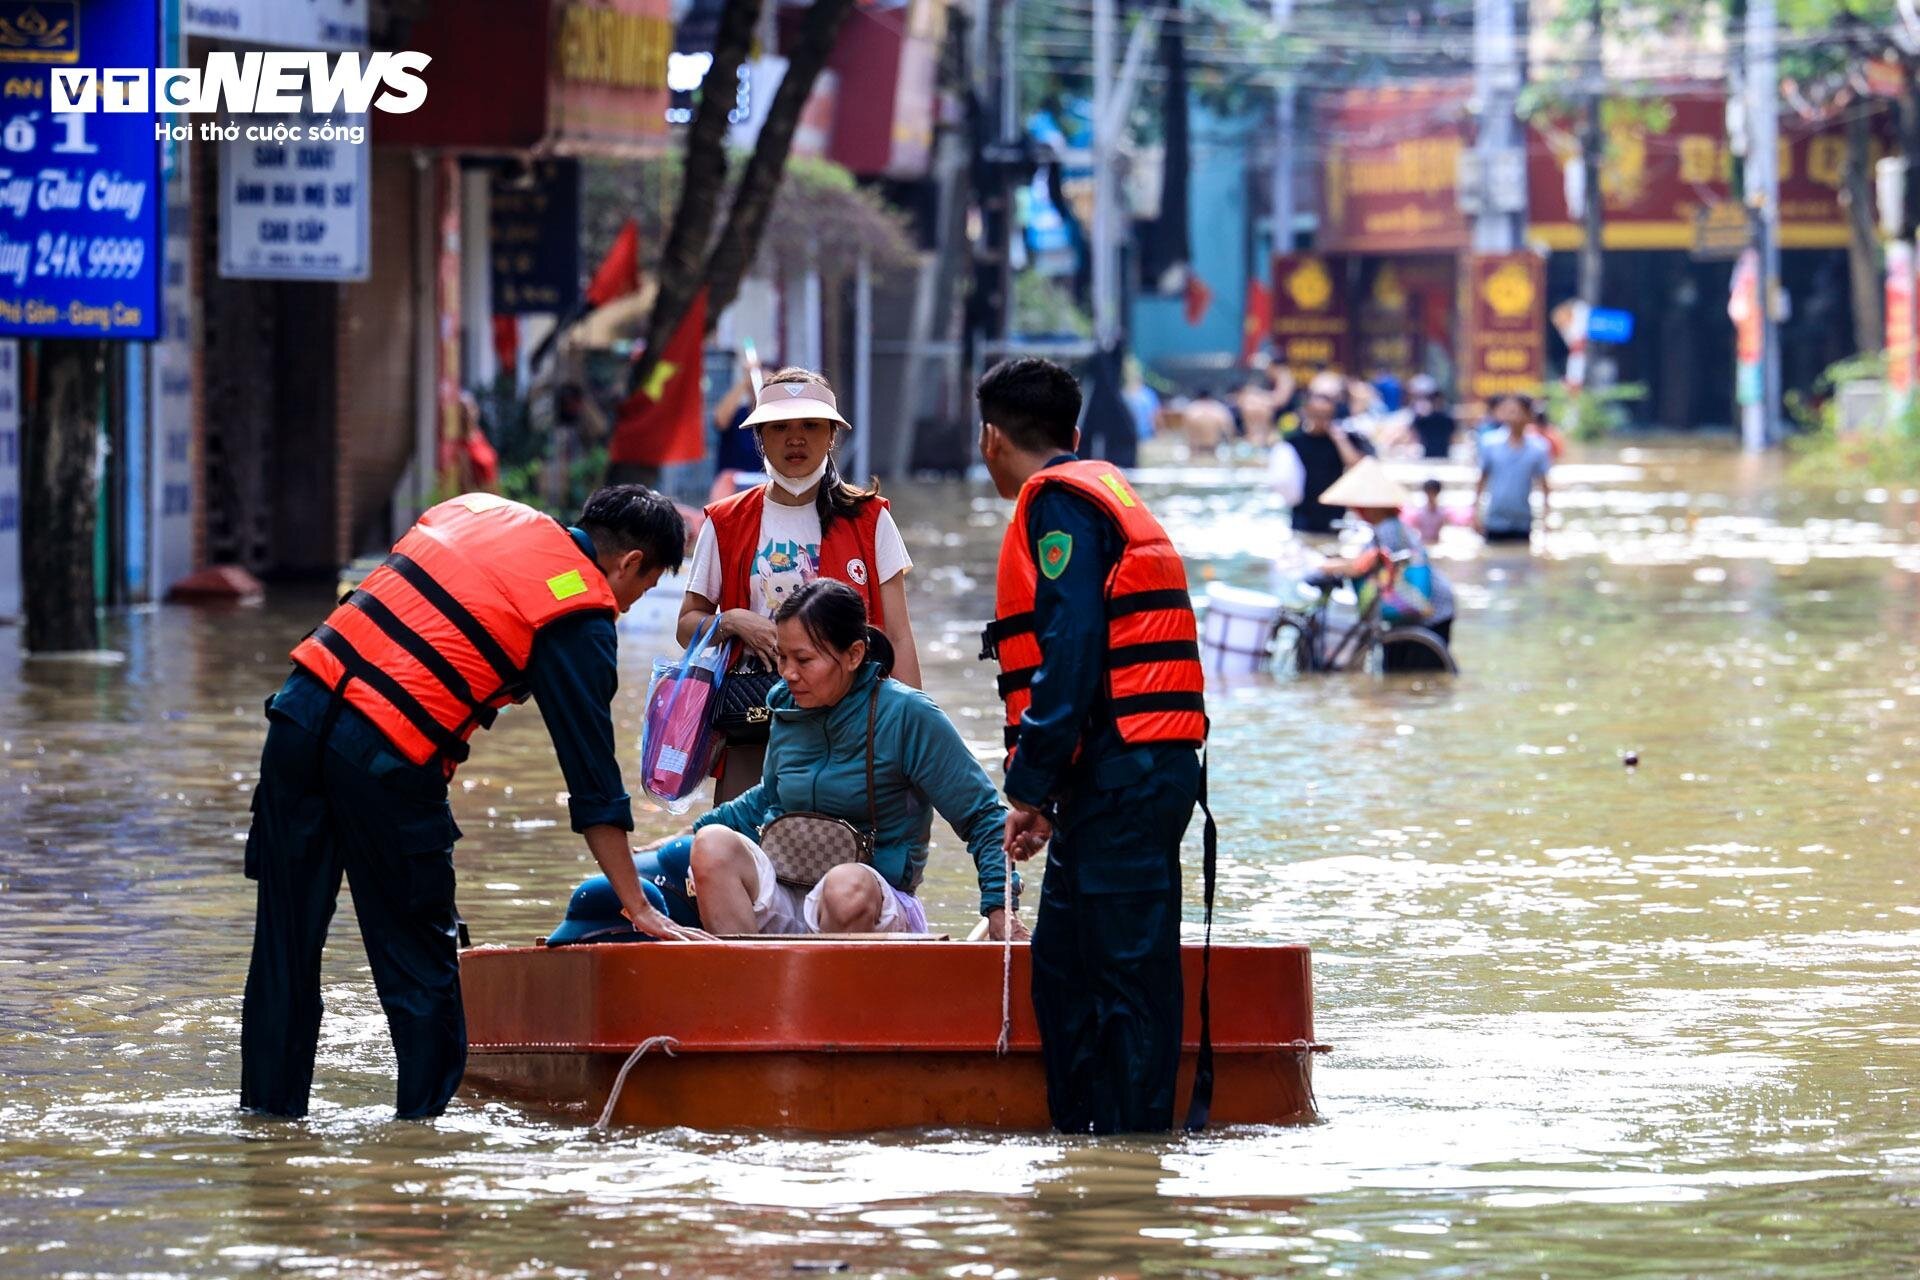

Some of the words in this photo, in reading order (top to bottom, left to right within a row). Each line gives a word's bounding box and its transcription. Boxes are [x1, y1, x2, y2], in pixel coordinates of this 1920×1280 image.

[0, 111, 40, 152] ố
[53, 112, 98, 153] 1
[86, 236, 144, 279] 9999
